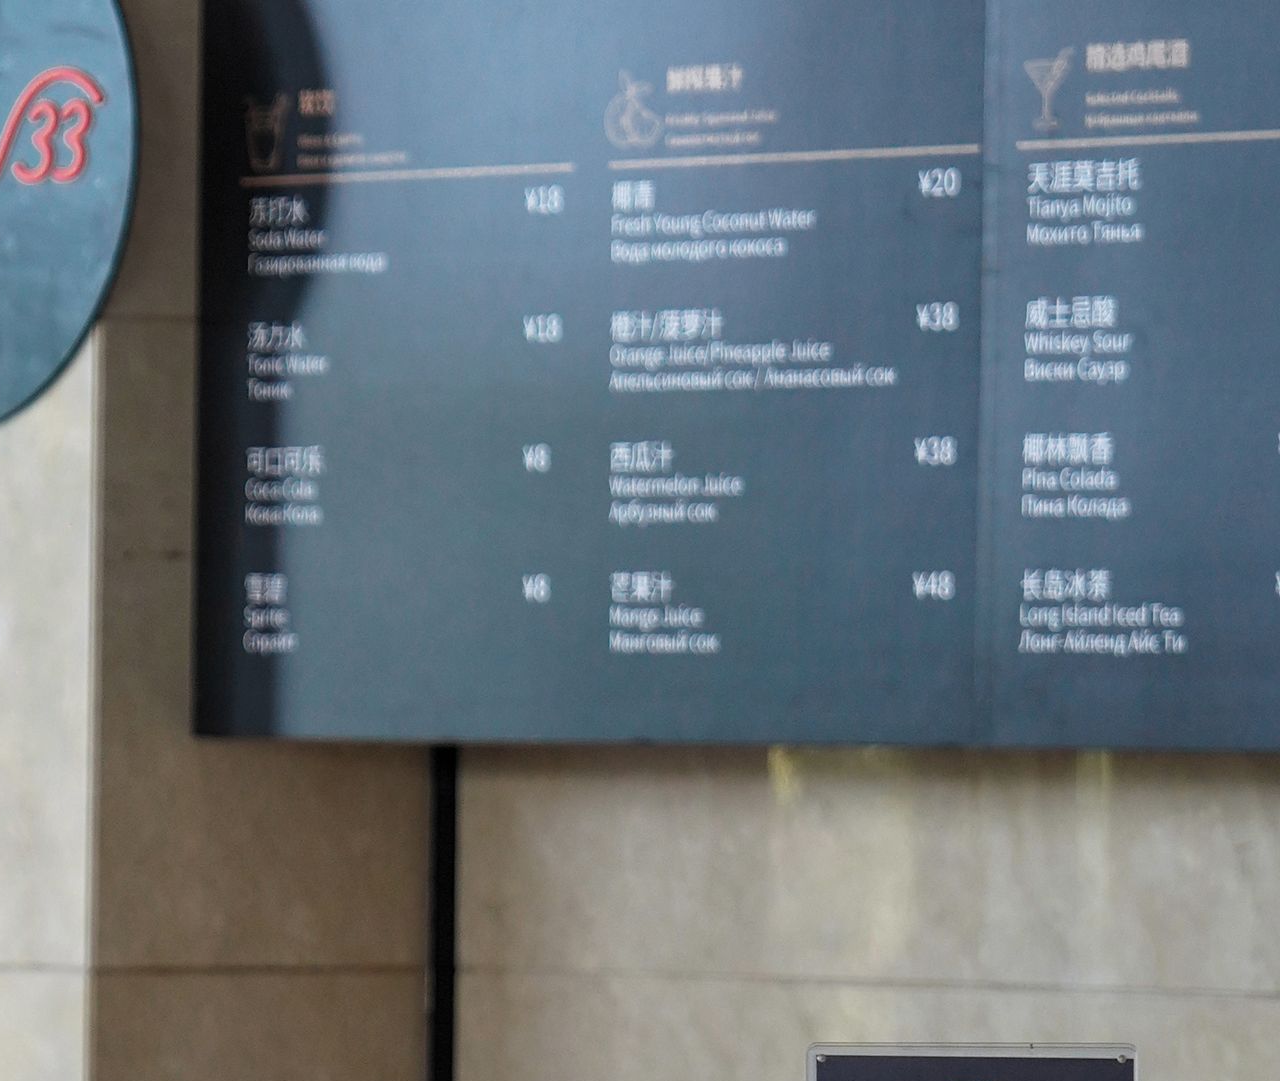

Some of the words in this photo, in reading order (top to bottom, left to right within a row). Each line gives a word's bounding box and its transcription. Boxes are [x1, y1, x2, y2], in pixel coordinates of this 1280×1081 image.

[918, 167, 961, 198] ¥20
[1027, 157, 1142, 193] 天涯莫吉托
[611, 213, 652, 237] Fresh
[653, 211, 701, 238] Young
[702, 208, 768, 233] Coconut
[768, 206, 817, 231] Water
[1026, 195, 1080, 222] Tianya
[1082, 193, 1136, 220] Mojito
[609, 343, 665, 370] Orange
[790, 337, 834, 361] Juice
[1024, 330, 1090, 356] Whiskey
[1092, 330, 1135, 353] Sour
[610, 440, 674, 472] 西瓜汁
[609, 472, 701, 498] Watermelon
[703, 471, 745, 498] Juice
[1060, 466, 1121, 492] Colada
[609, 605, 661, 631] Mango
[663, 603, 705, 628] Juice
[1019, 602, 1061, 631] Long
[1062, 601, 1112, 627] Island
[1113, 602, 1151, 627] Iced
[1151, 602, 1185, 627] Tea
